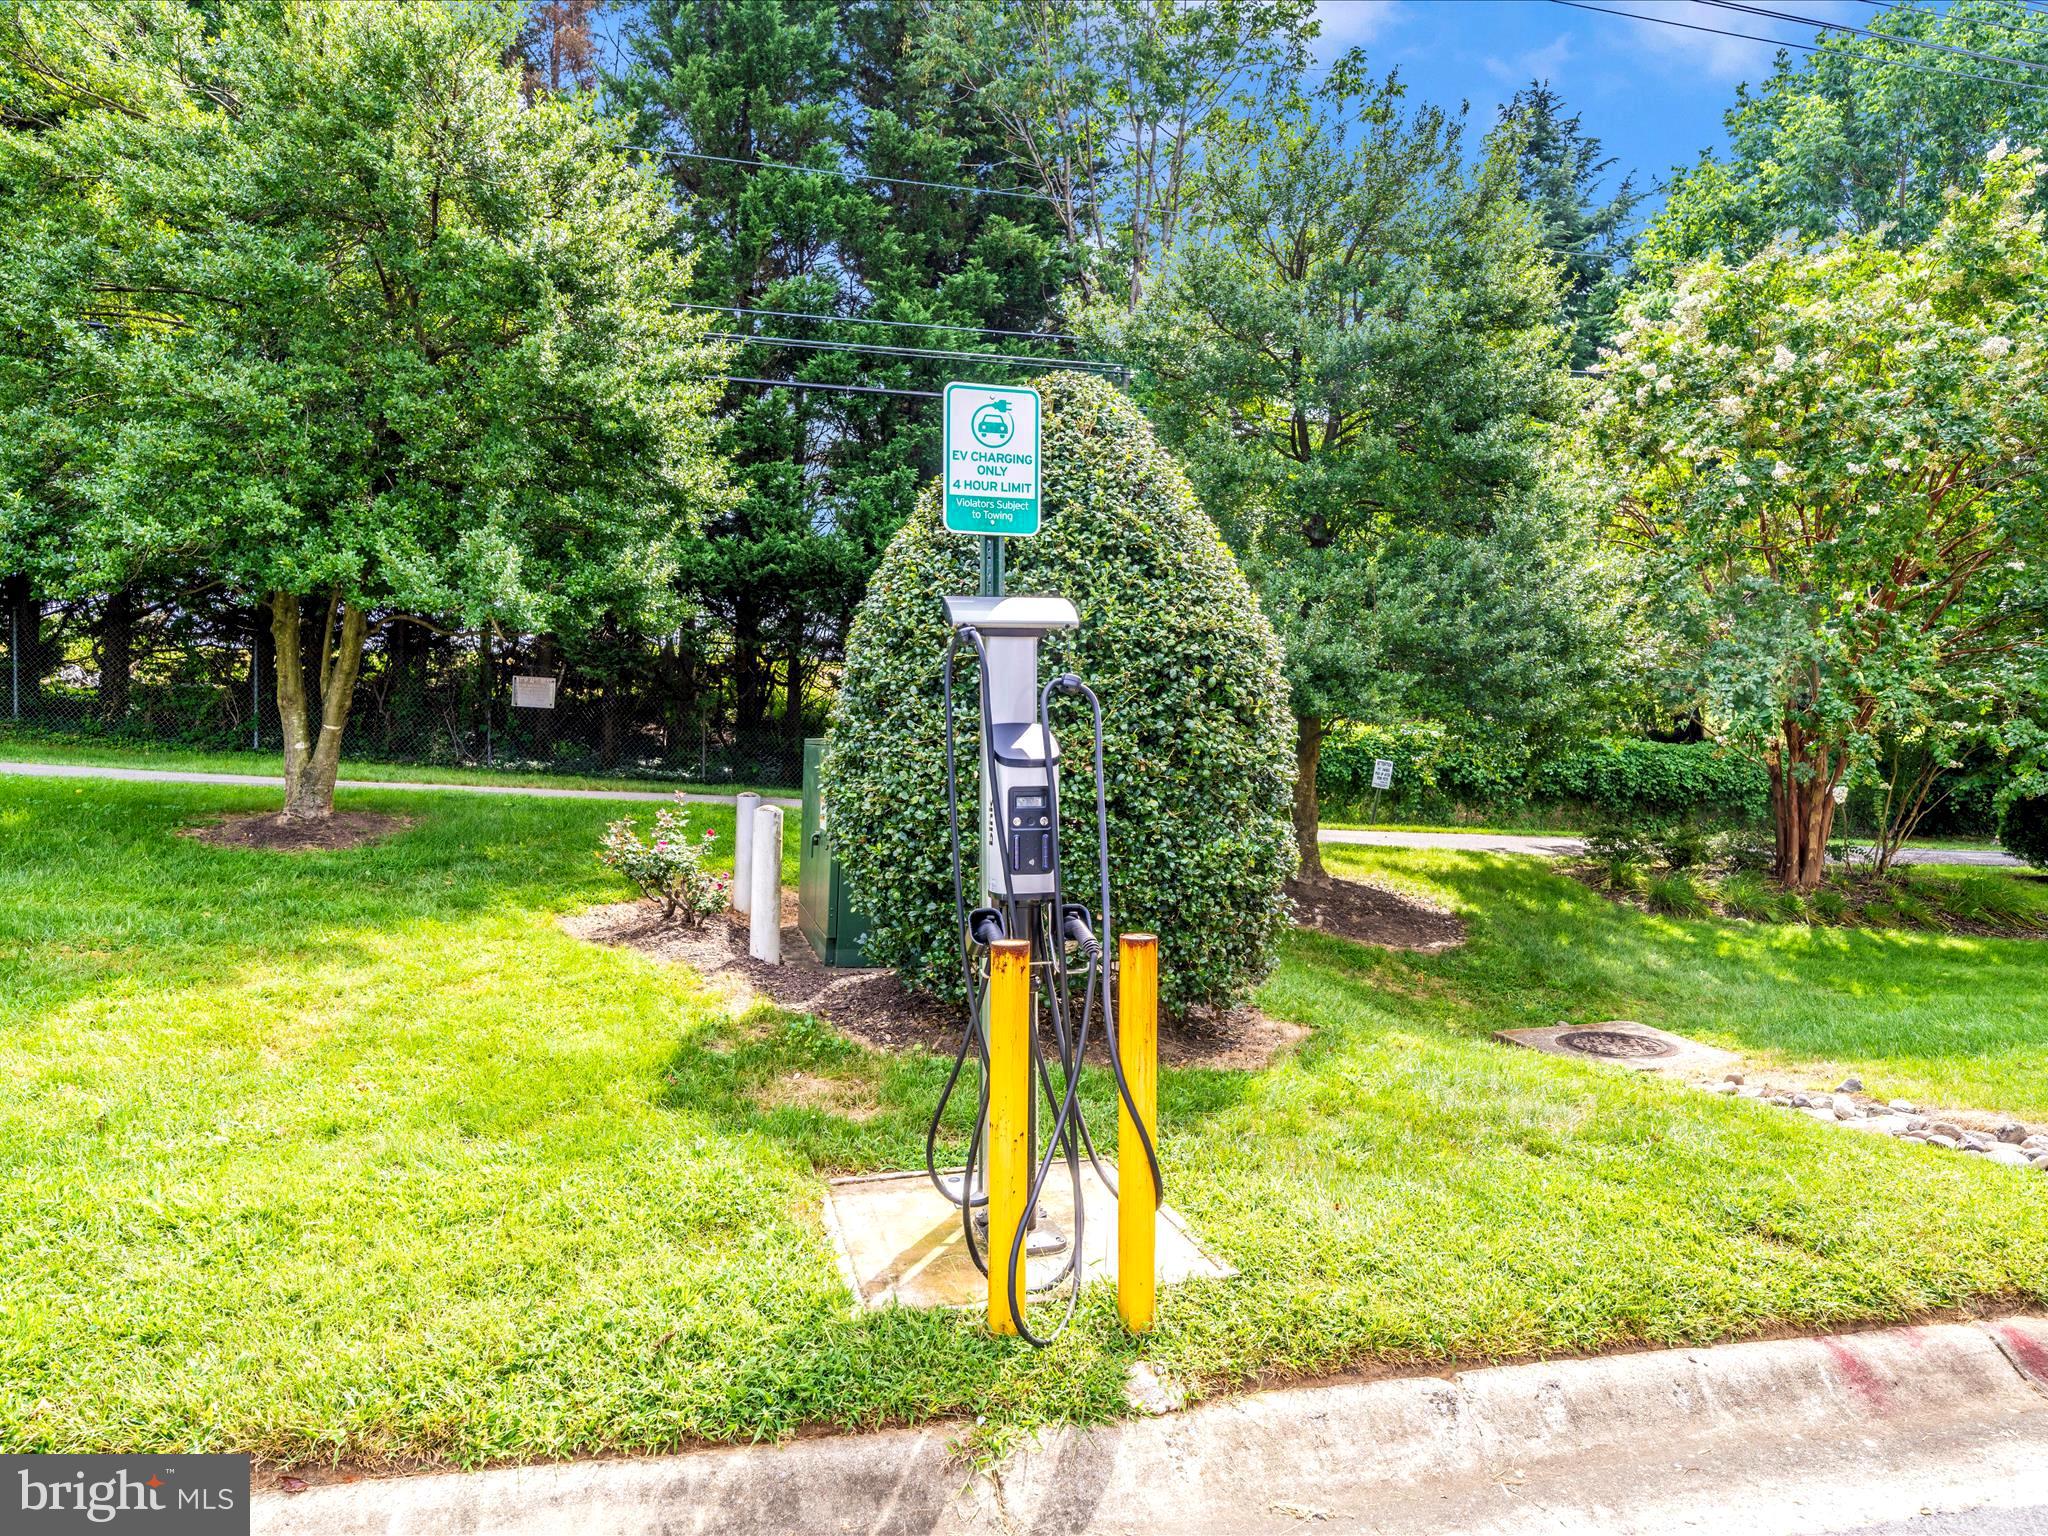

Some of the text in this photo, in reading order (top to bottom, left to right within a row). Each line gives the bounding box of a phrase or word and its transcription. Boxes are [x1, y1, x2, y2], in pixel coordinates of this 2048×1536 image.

[952, 450, 1033, 465] EV CHARGING
[977, 465, 1008, 477] ONLY
[952, 479, 1032, 493] 4 HOUR LIMIT
[956, 497, 1029, 511] Violators Subject
[972, 511, 1013, 522] to Towing
